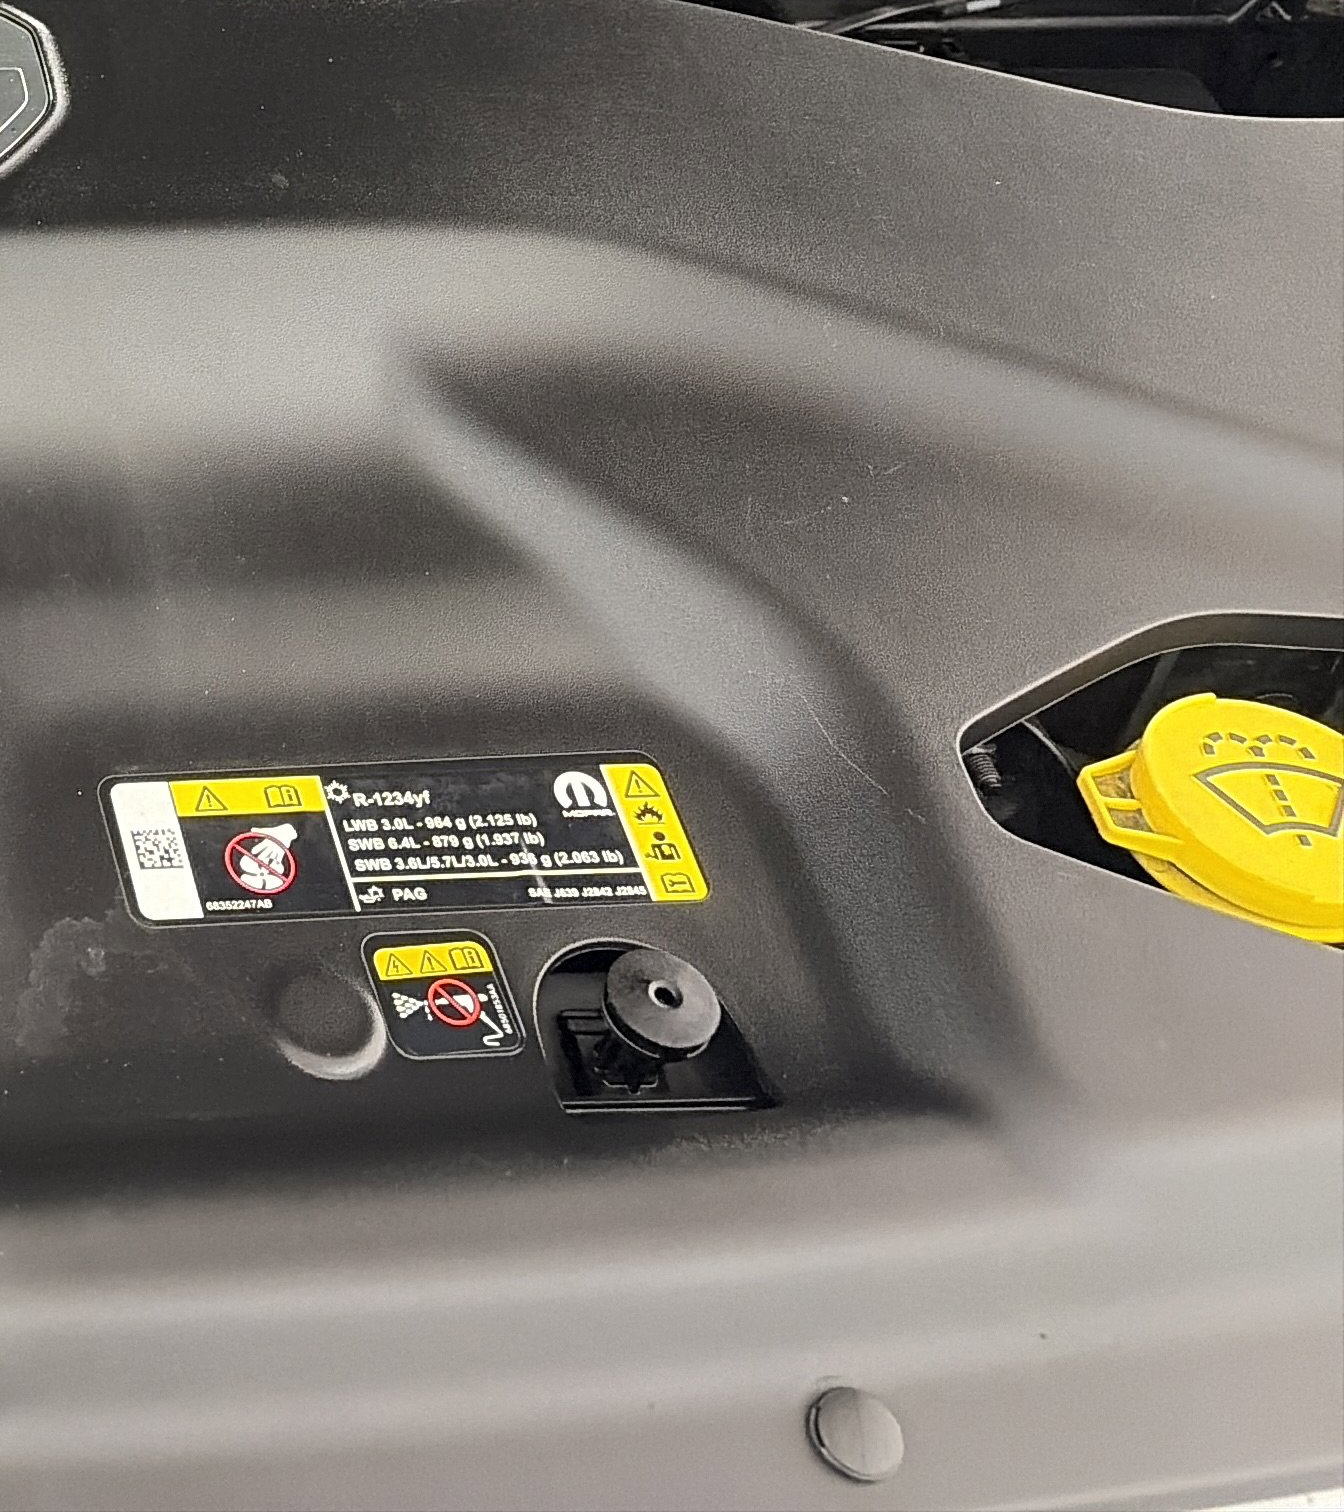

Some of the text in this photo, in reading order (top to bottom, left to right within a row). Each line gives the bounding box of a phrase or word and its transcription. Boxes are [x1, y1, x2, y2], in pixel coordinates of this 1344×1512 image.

[352, 790, 430, 808] R-1234yf
[343, 818, 378, 832] LWB
[381, 817, 414, 830] 3.0L
[455, 817, 467, 830] g
[469, 814, 514, 829] (2.125
[516, 813, 538, 828] lb)
[348, 837, 385, 851] SWB
[388, 836, 421, 849] 6.4L
[432, 835, 460, 848] 879
[462, 836, 474, 849] g
[476, 832, 520, 849] (1.937
[523, 832, 545, 847] lb)
[354, 857, 392, 872] SWB
[394, 853, 499, 870] 3.6L/5.7L/3.0L
[540, 854, 553, 868] g
[554, 851, 600, 867] (2.063
[602, 849, 625, 865] lb)
[392, 887, 428, 901] PAG
